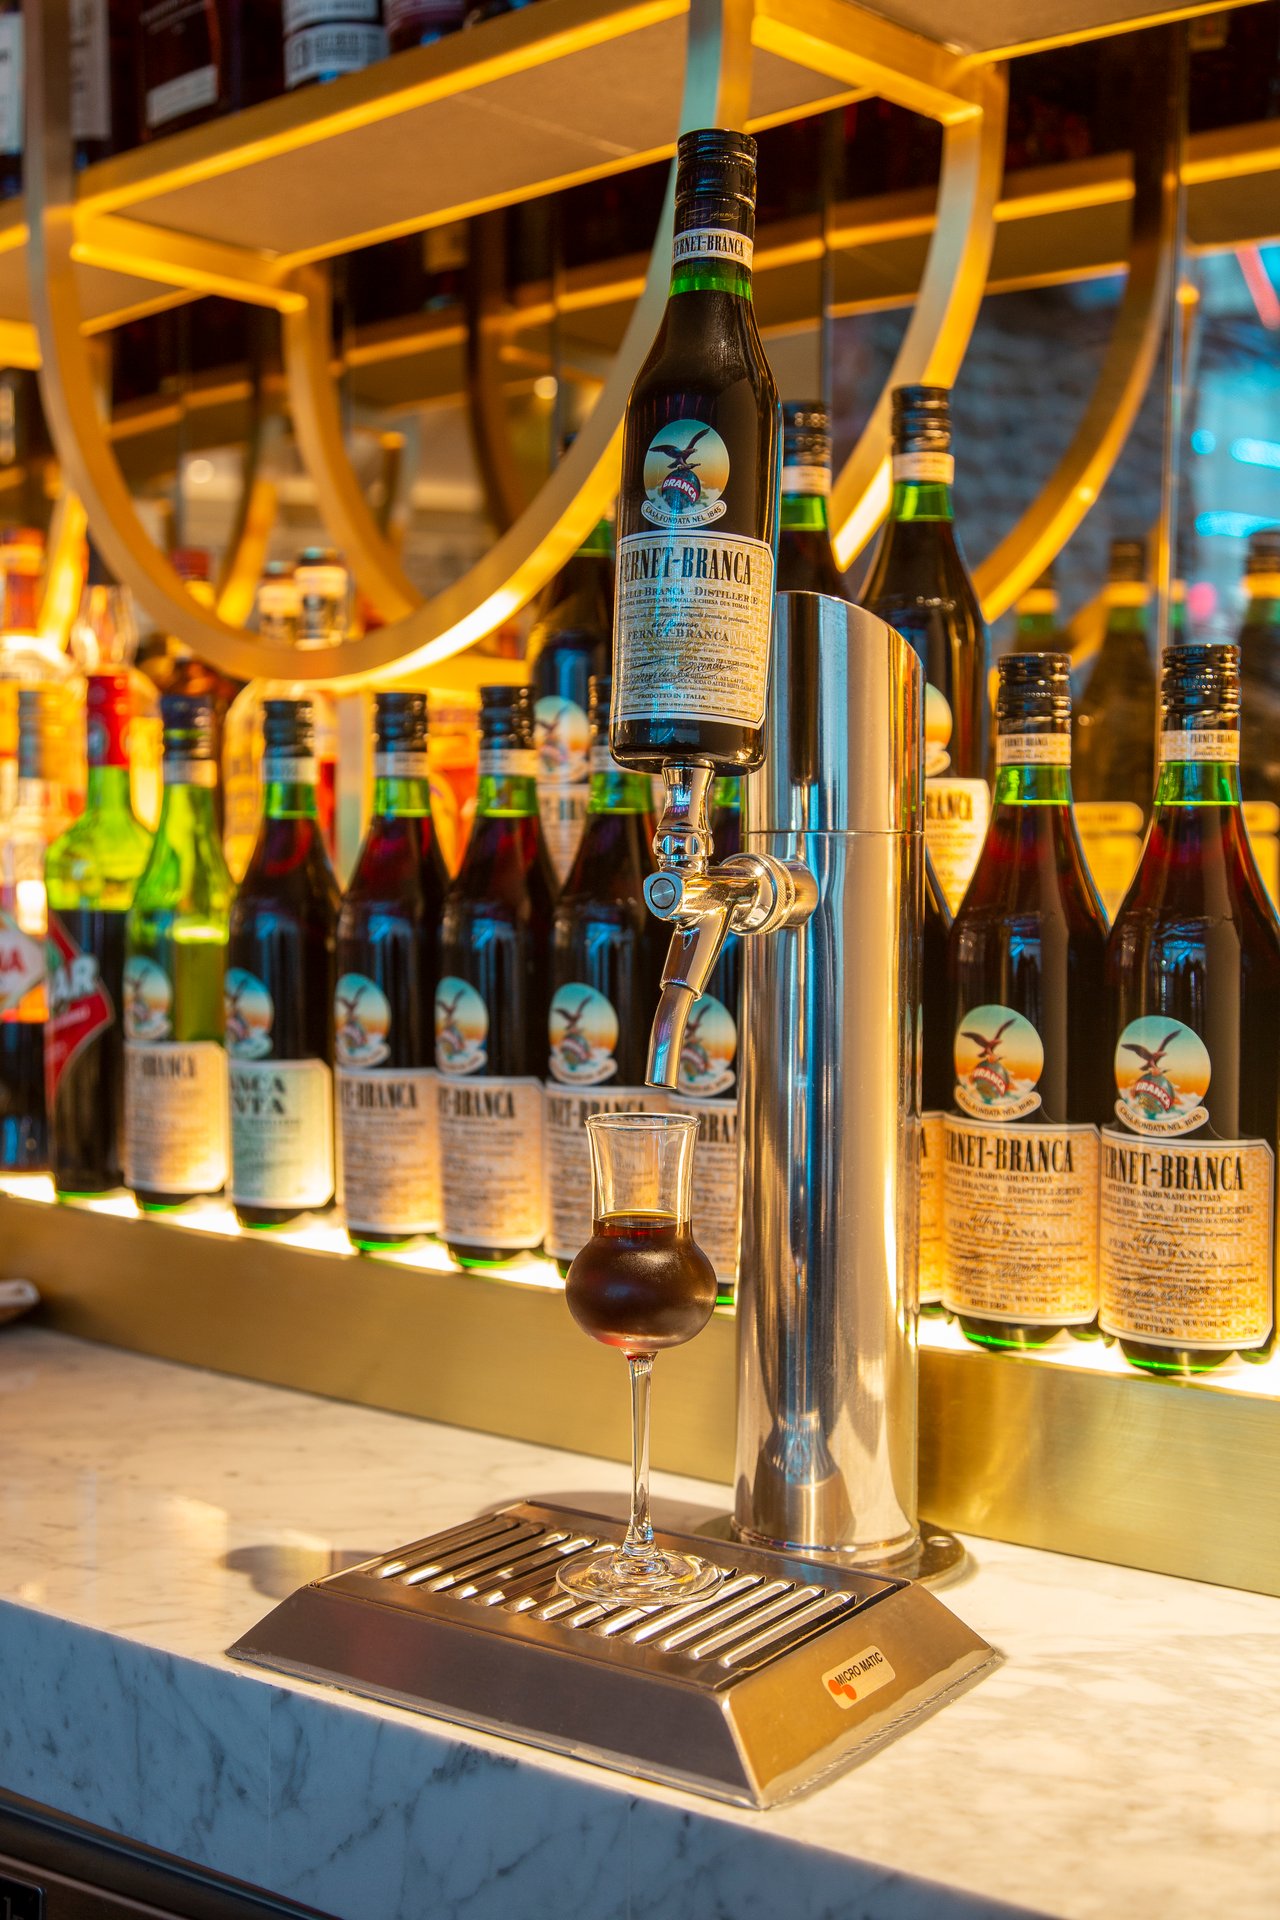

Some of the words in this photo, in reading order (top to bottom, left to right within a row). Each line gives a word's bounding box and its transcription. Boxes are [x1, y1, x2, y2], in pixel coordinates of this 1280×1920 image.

[663, 478, 697, 502] BRANCA
[646, 507, 659, 520] CASA
[660, 514, 691, 524] FONDATA
[692, 515, 705, 523] NEL
[708, 506, 721, 518] 1845
[834, 1665, 861, 1686] MICRO
[859, 1652, 883, 1671] MATIC
